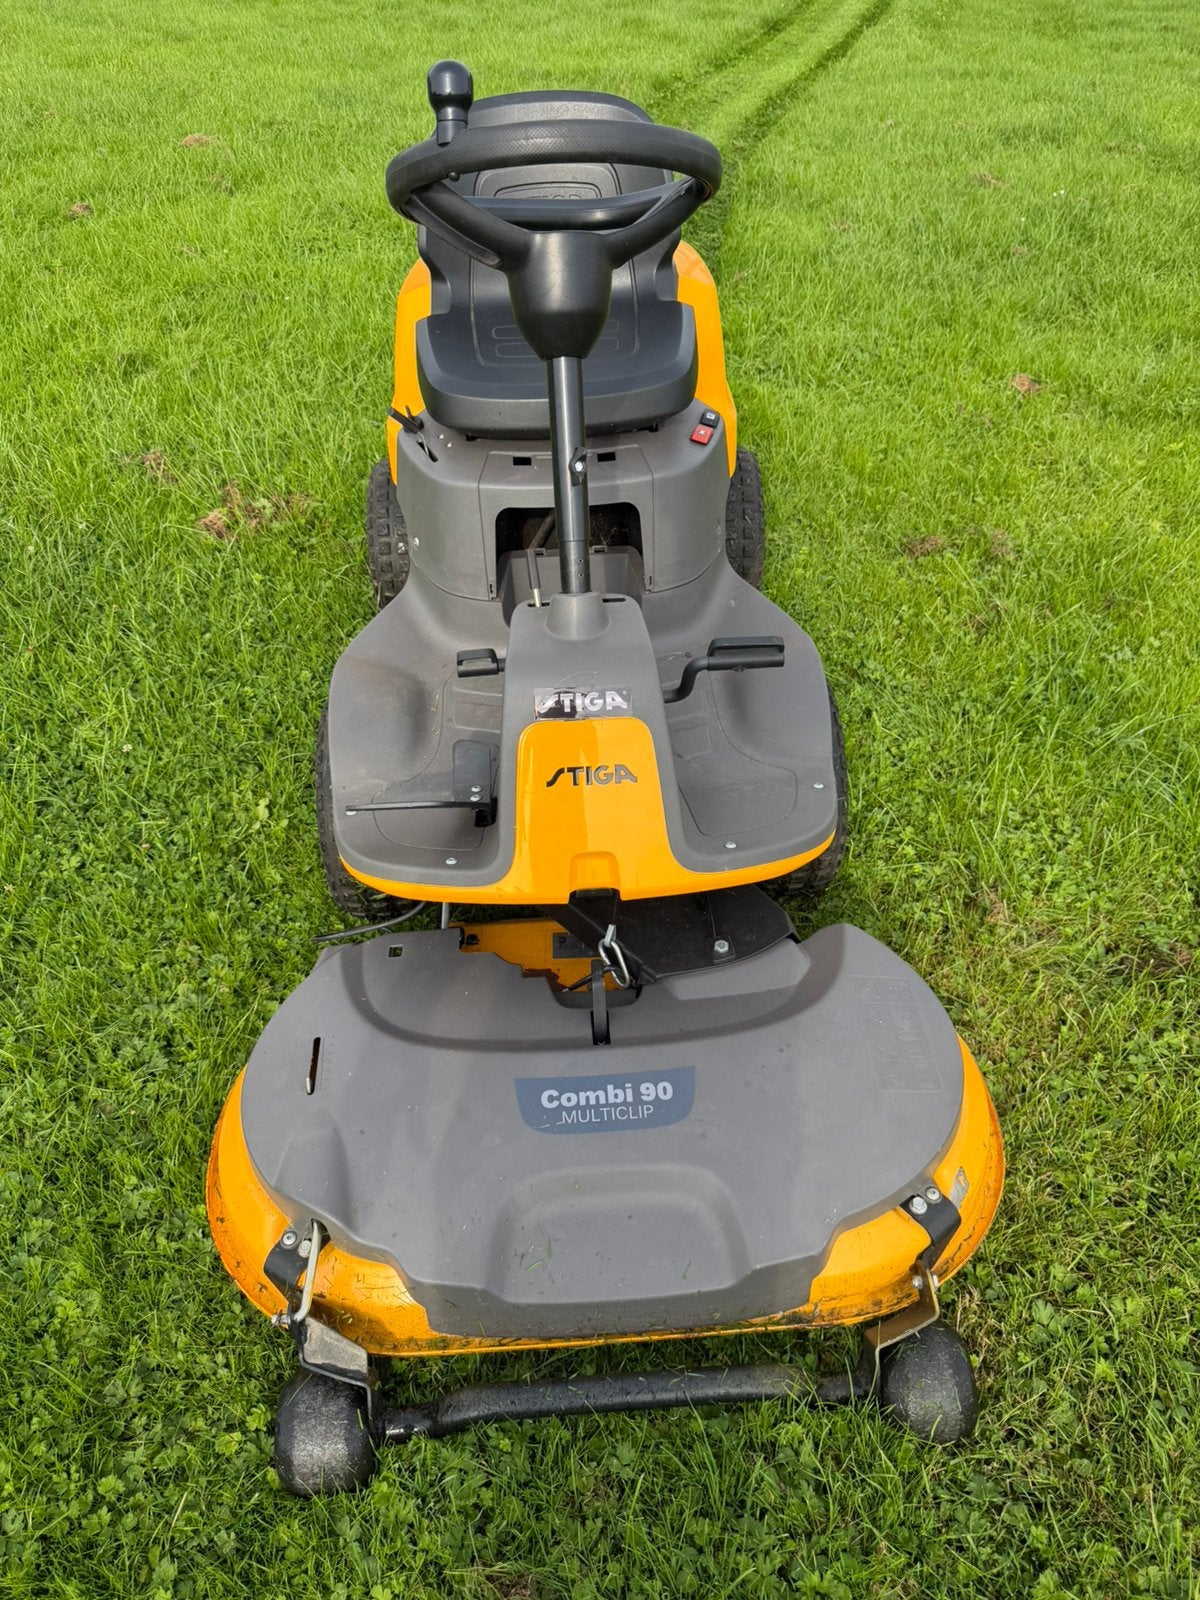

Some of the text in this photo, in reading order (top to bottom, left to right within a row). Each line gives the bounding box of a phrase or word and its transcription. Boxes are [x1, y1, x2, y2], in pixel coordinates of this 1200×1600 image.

[539, 690, 628, 714] STIGA
[545, 764, 638, 788] STIGA
[540, 1081, 674, 1109] Combi 90
[561, 1104, 654, 1124] MULTICLIP
